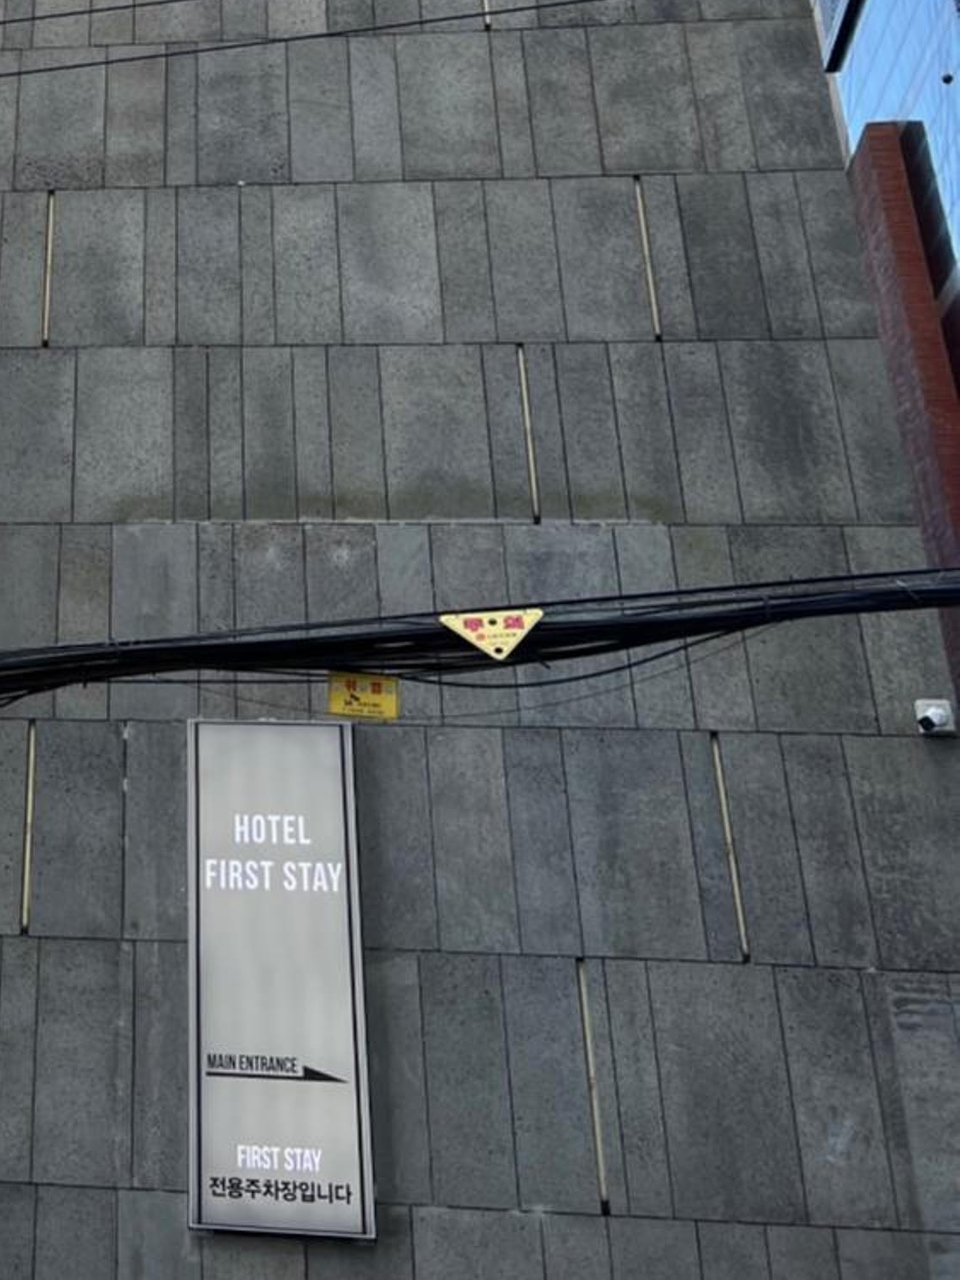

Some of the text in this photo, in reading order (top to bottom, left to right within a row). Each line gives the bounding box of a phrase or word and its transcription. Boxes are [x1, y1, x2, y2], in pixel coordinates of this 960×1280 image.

[234, 813, 312, 845] HOTEL
[205, 858, 342, 892] FIRST STAY
[206, 1053, 299, 1074] MAIN ENTRANCE
[237, 1144, 323, 1173] FIRST STAY
[209, 1176, 352, 1204] 전용주차장입니다
